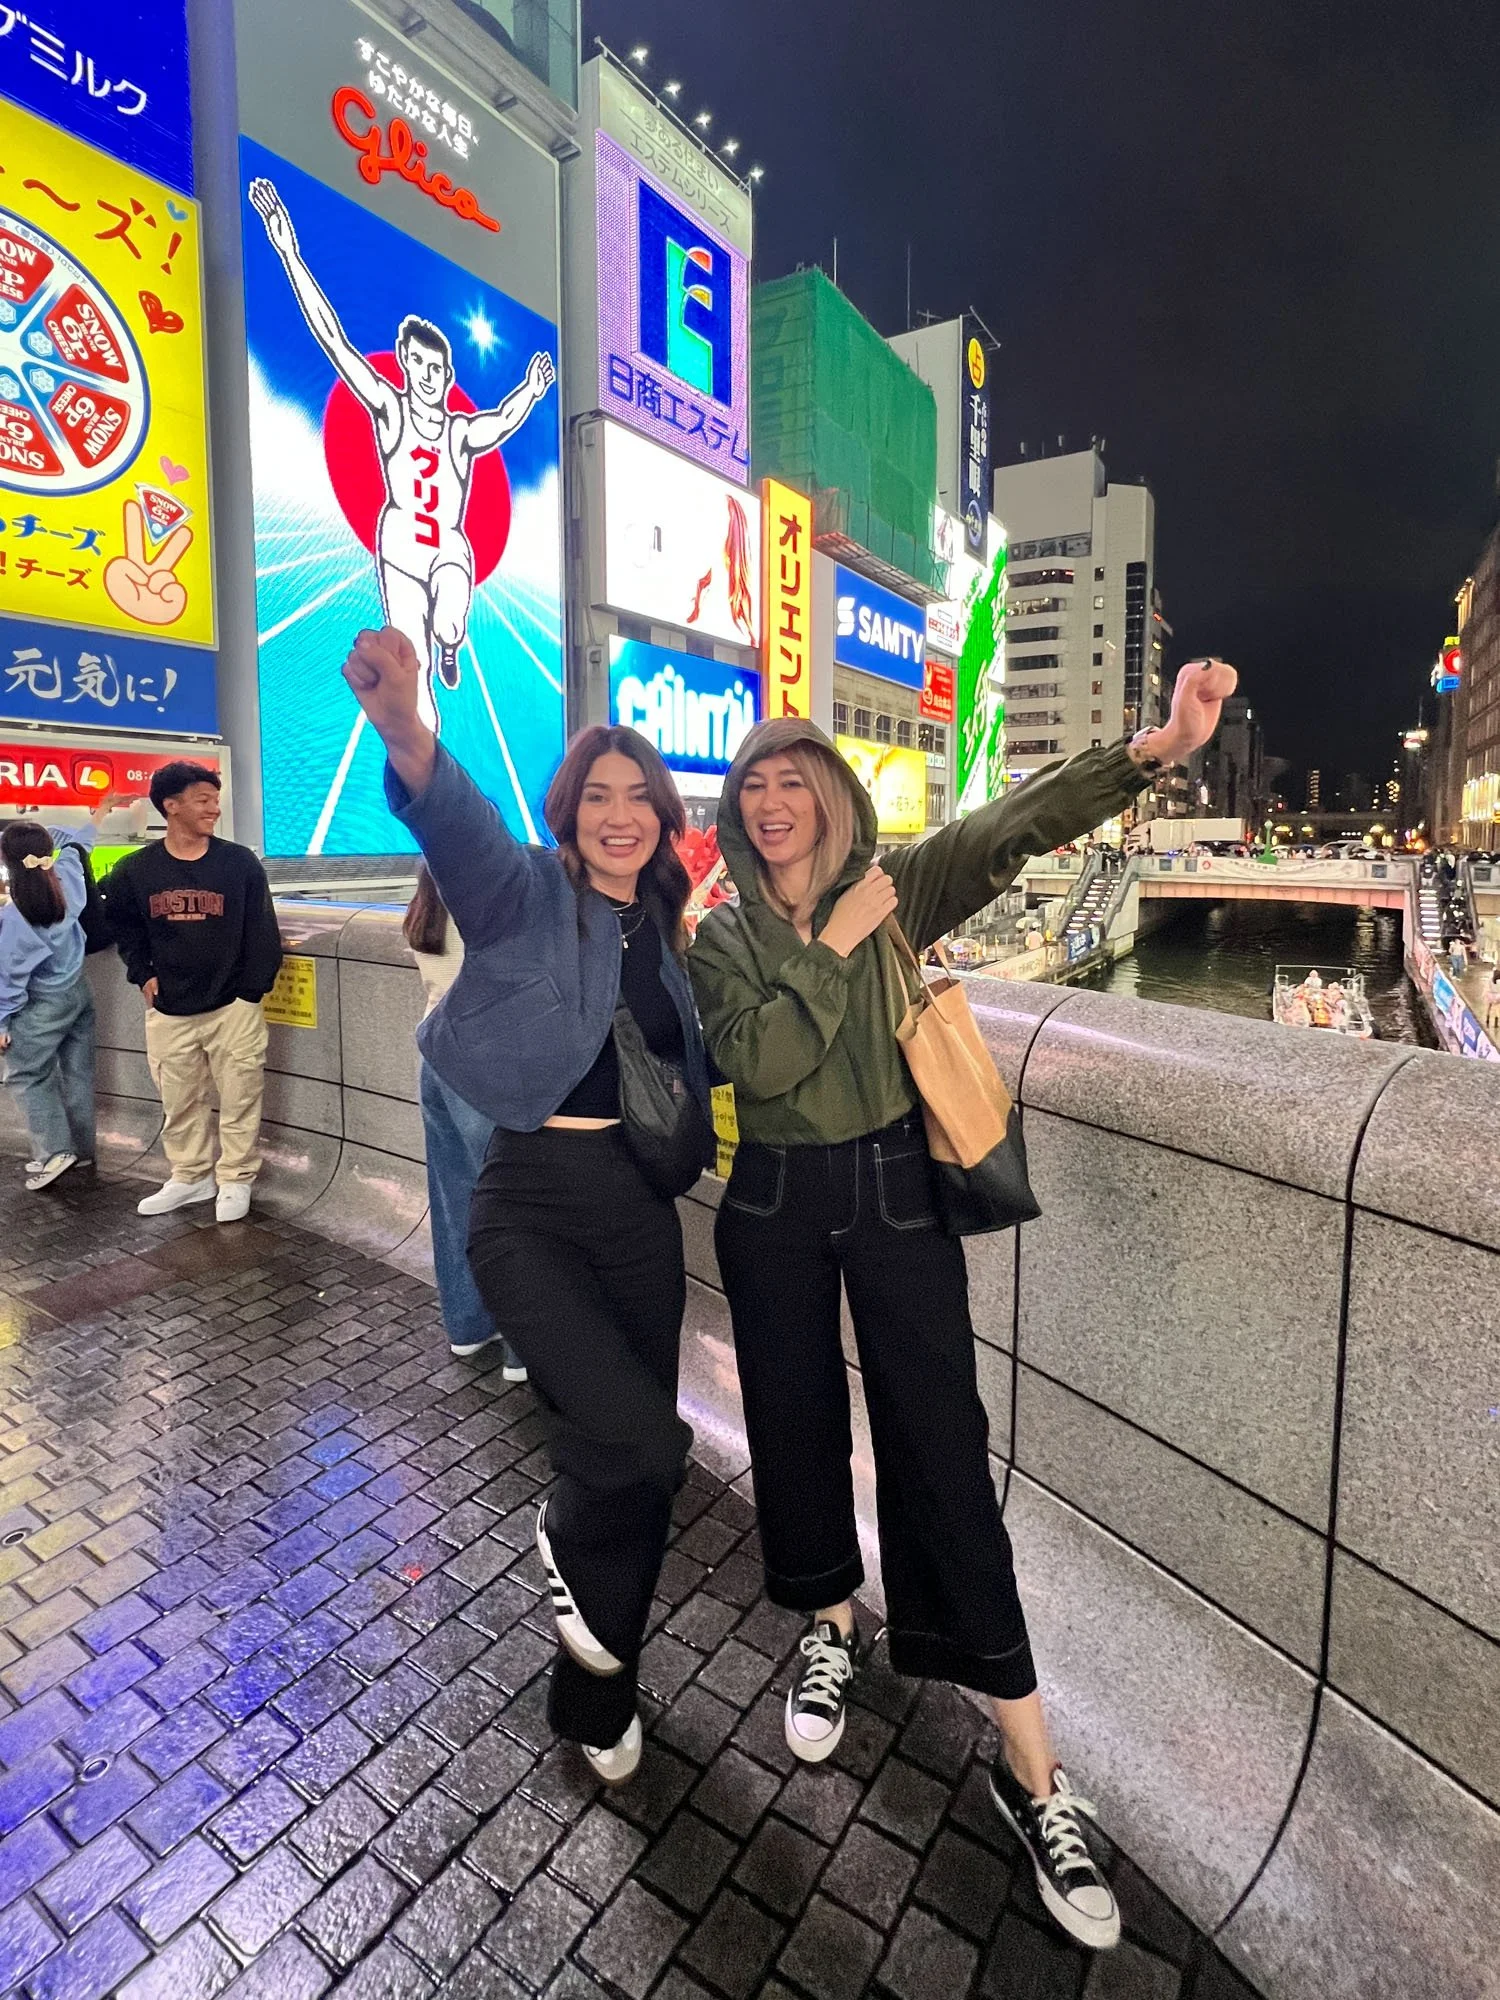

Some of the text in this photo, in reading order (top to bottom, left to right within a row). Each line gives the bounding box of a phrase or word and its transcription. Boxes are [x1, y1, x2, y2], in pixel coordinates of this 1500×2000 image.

[367, 69, 470, 161] ゆたかな人生
[332, 85, 501, 232] Glico
[47, 320, 75, 361] CHEESE
[61, 315, 90, 360] 6P
[77, 303, 123, 369] SNOW
[79, 323, 98, 352] BRAND
[51, 384, 77, 415] CHEESE
[64, 396, 96, 428] 6P
[82, 406, 123, 460] SNOW
[150, 494, 179, 514] SNOW
[409, 444, 441, 549] グリコ
[0, 513, 106, 556] チーズ
[858, 606, 924, 664] SAMTY
[4, 647, 177, 713] 元気に!
[149, 889, 224, 918] BOSTON
